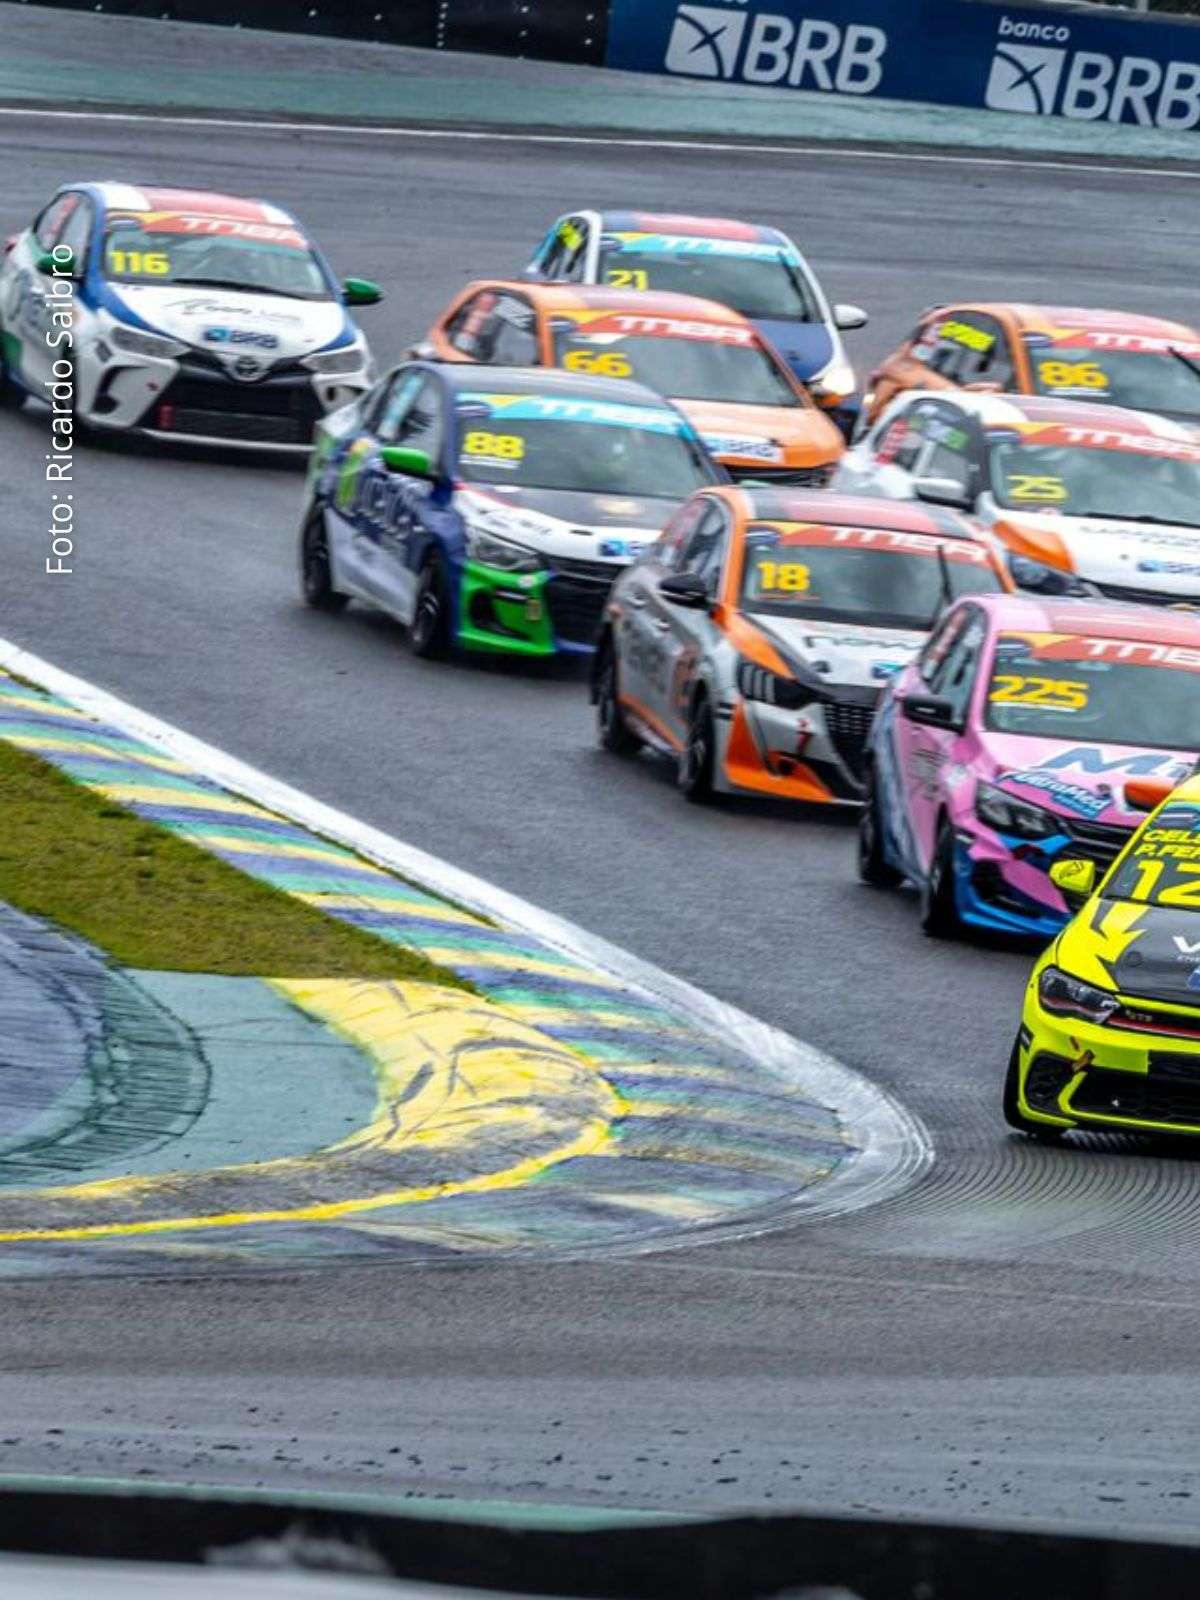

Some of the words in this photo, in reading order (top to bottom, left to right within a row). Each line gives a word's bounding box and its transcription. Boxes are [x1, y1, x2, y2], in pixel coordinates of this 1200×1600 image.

[999, 16, 1070, 42] banco
[742, 14, 887, 94] BRB
[110, 250, 170, 274] 116
[607, 270, 649, 291] 21
[1039, 360, 1109, 388] 86
[462, 431, 526, 459] 88
[1007, 475, 1069, 503] 25
[757, 560, 810, 591] 18
[990, 676, 1089, 709] 225
